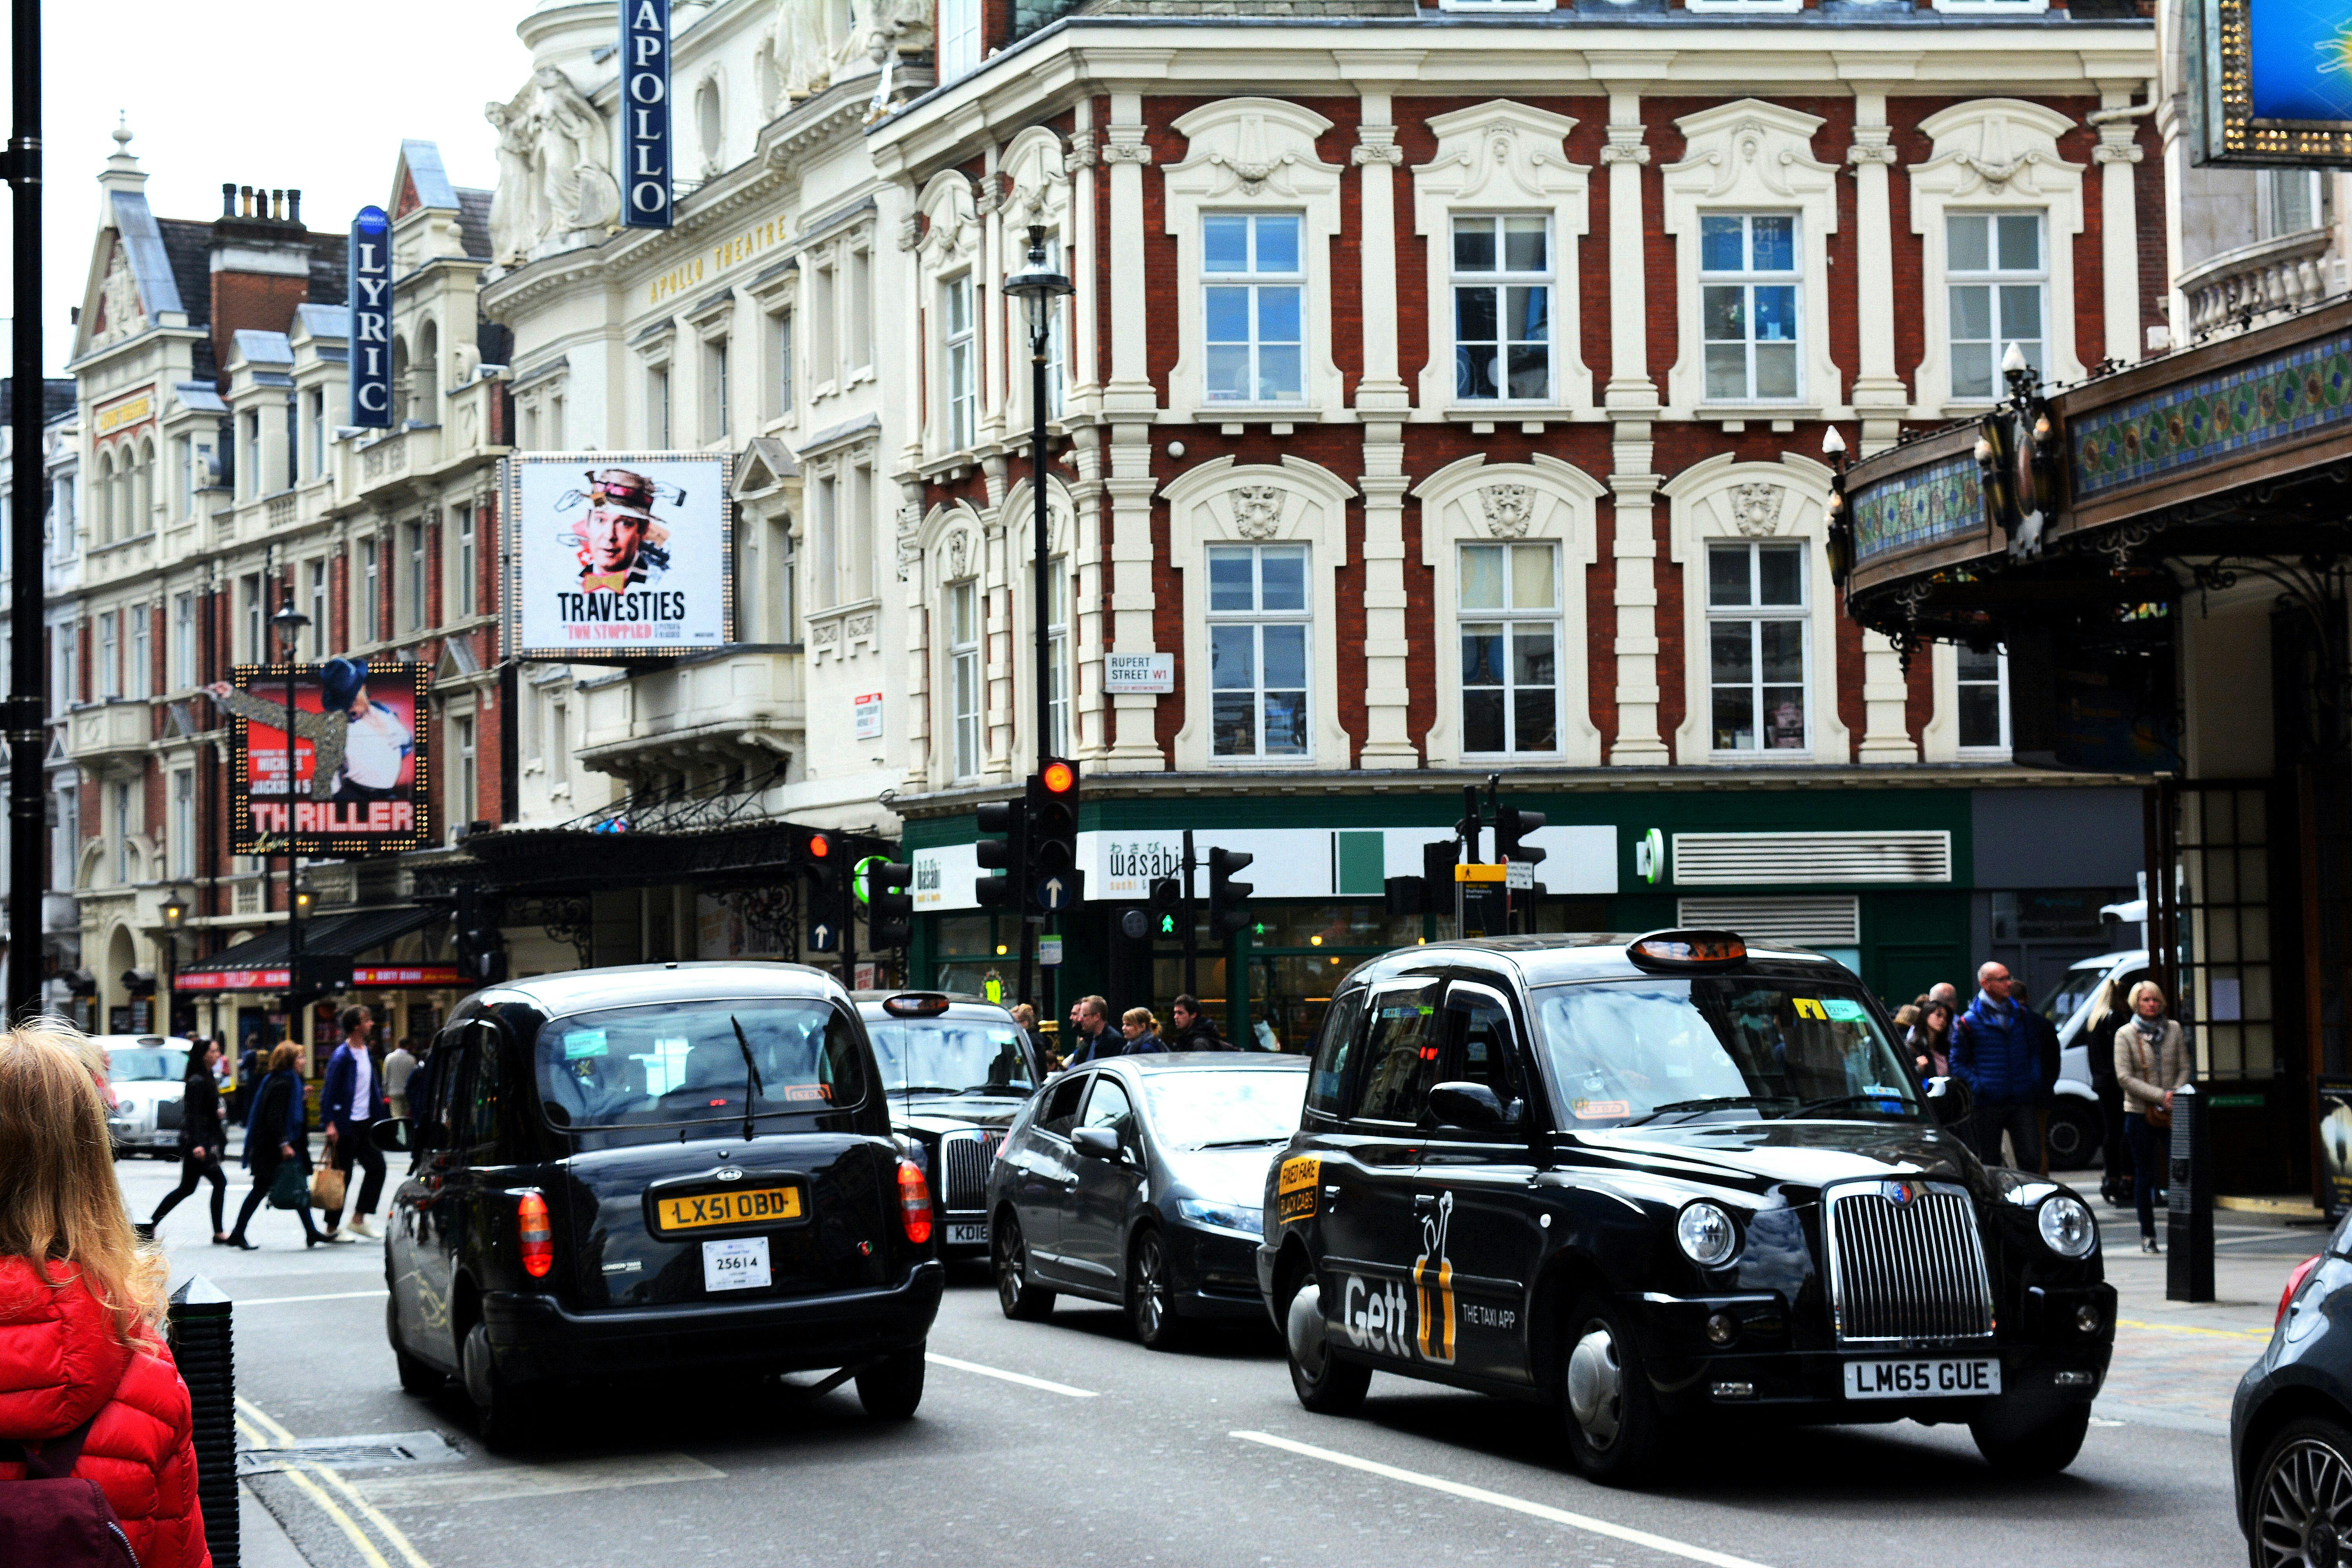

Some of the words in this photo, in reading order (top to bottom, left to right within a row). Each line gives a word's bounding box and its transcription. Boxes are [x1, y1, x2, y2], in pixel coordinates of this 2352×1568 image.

[630, 0, 666, 213] APOLLO
[650, 258, 704, 304] APOLLO
[714, 215, 786, 271] THEATRE
[357, 243, 387, 411] LYRIC
[557, 592, 685, 622] TRAVESTIES
[1112, 657, 1151, 667] RUPERT
[1112, 669, 1148, 679] STREET
[1153, 670, 1167, 679] W1
[249, 801, 414, 833] THRILLER
[1111, 841, 1160, 854] わさび
[1111, 846, 1179, 876] wasabi
[1299, 1160, 1316, 1180] FARE
[675, 1196, 731, 1224] LX51
[737, 1192, 784, 1216] OBD
[1298, 1191, 1314, 1210] CABS
[717, 1256, 757, 1270] 25614
[1345, 1274, 1411, 1358] Gett
[1462, 1304, 1479, 1323] THE
[1479, 1306, 1497, 1327] TAXI
[1498, 1309, 1515, 1328] APP
[1856, 1364, 1931, 1392] LM65
[1938, 1362, 1989, 1390] GUE
